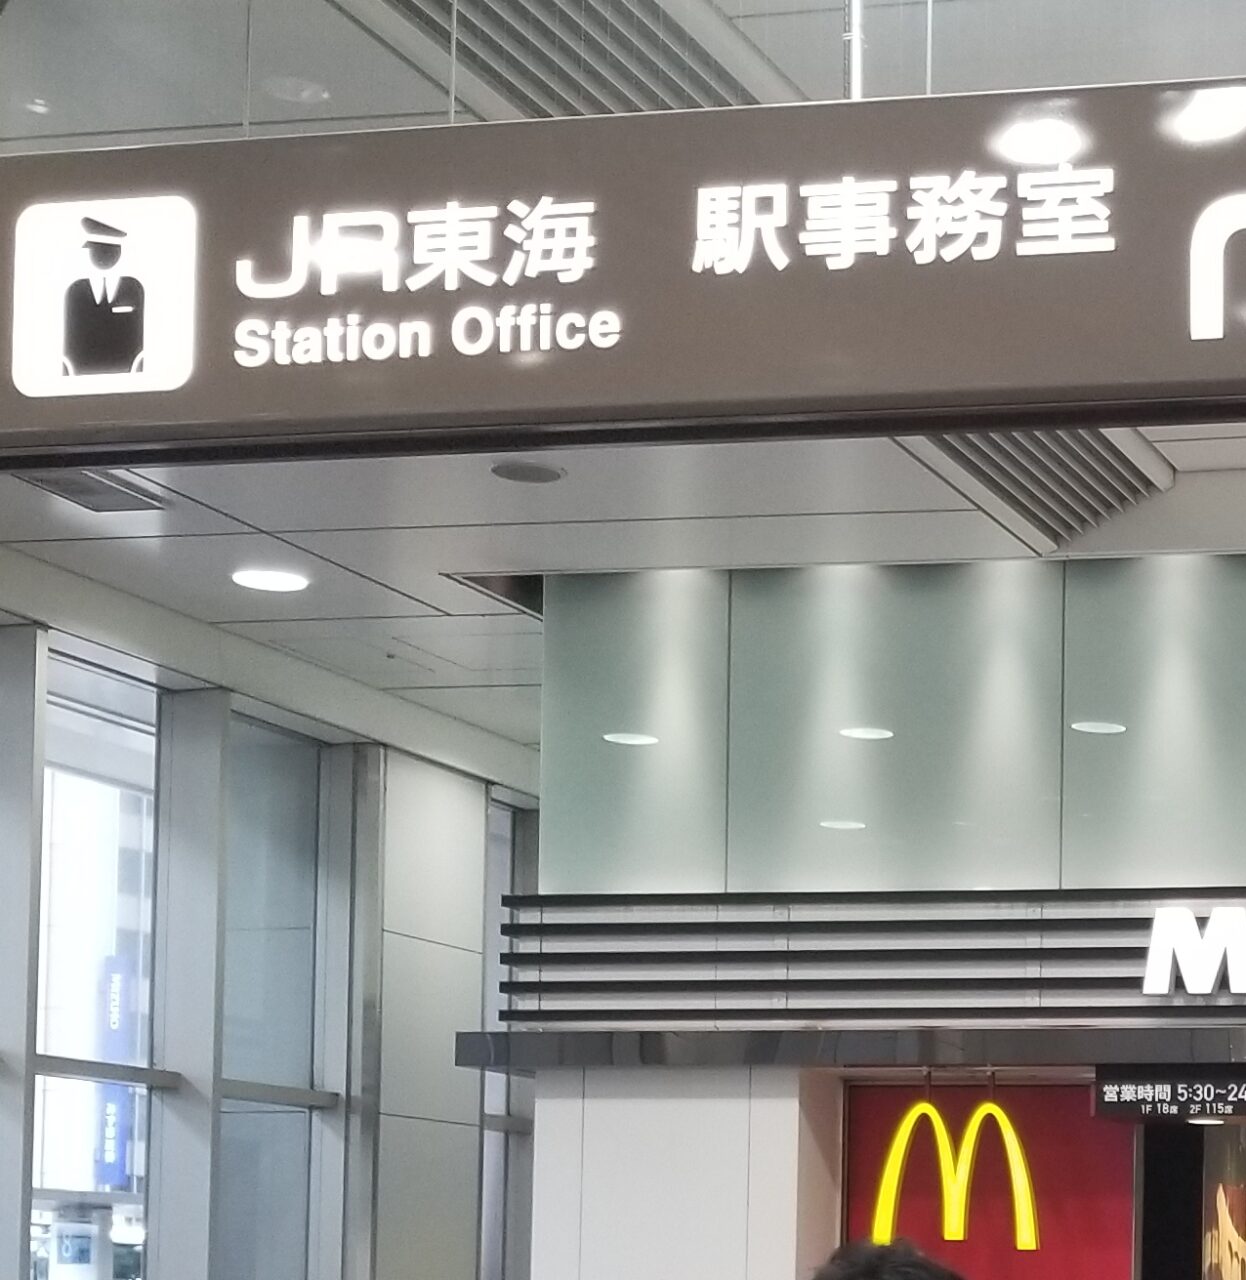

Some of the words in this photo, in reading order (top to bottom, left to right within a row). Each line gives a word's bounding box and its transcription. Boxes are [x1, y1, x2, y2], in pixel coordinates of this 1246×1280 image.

[235, 196, 597, 299] JR東海
[691, 164, 1116, 275] 駅事務室
[233, 314, 432, 368] Station
[451, 303, 621, 356] Office
[1102, 1083, 1172, 1102] 営業時間
[1141, 1104, 1153, 1115] 1F
[1189, 1104, 1202, 1114] 2F
